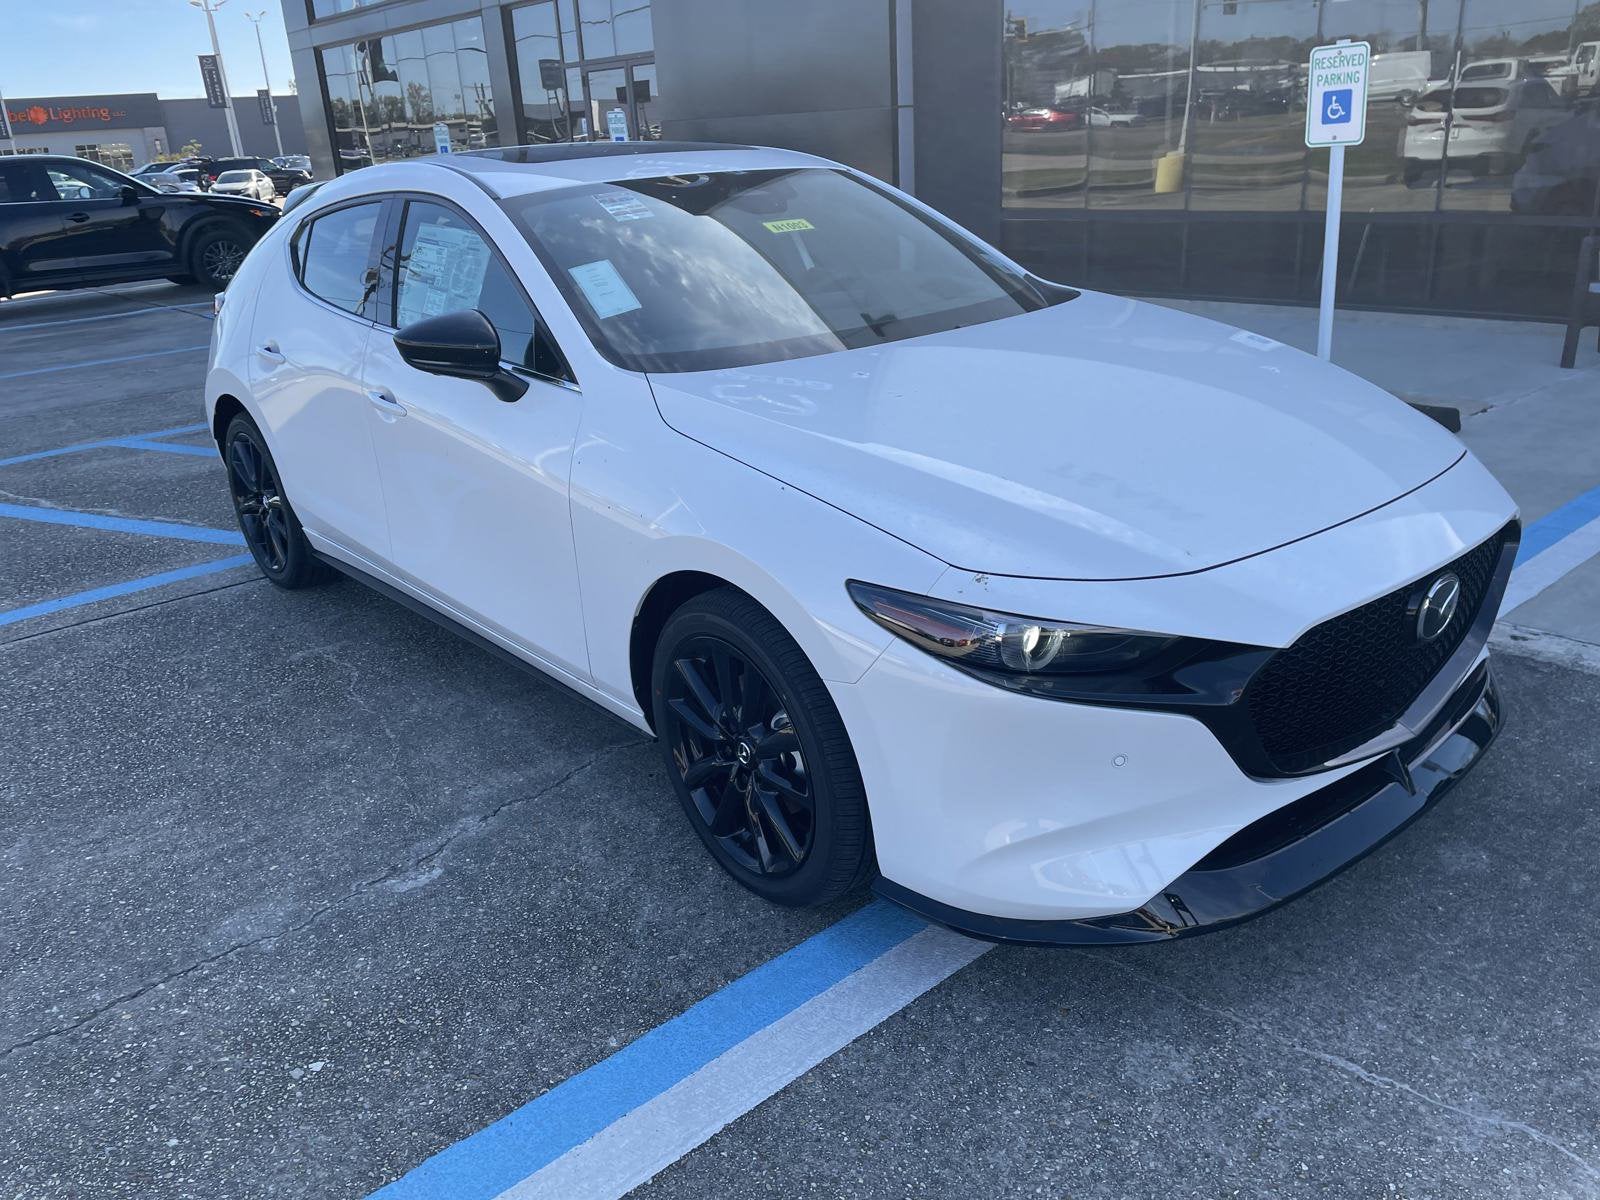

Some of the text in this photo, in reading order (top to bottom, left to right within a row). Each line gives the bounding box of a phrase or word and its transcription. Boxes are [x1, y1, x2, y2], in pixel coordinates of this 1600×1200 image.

[1314, 53, 1365, 70] RESERVED
[1317, 71, 1360, 87] PARKING
[49, 107, 110, 122] Lighting
